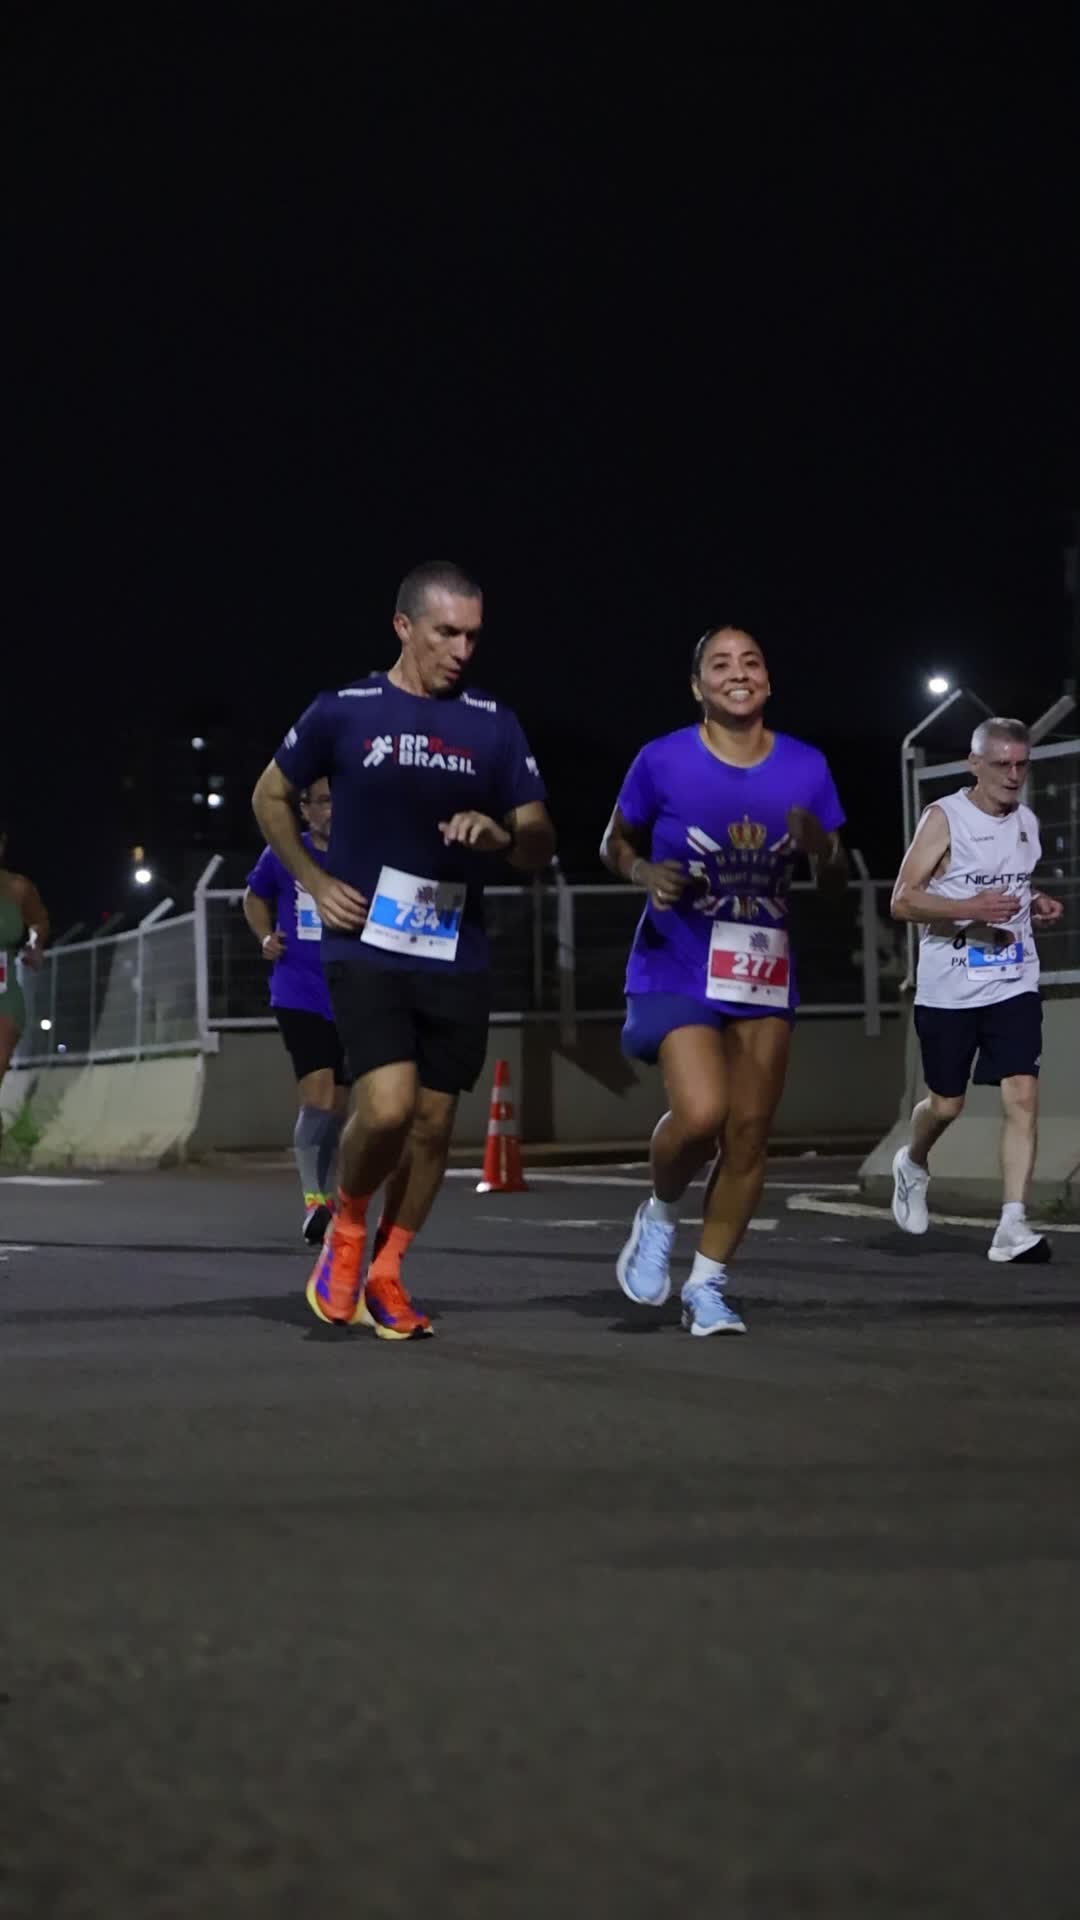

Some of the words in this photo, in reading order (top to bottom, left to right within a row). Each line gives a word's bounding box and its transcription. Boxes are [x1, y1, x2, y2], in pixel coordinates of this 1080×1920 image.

[398, 751, 477, 776] BRASIL
[965, 873, 1015, 885] NIGHT
[731, 952, 778, 979] 277
